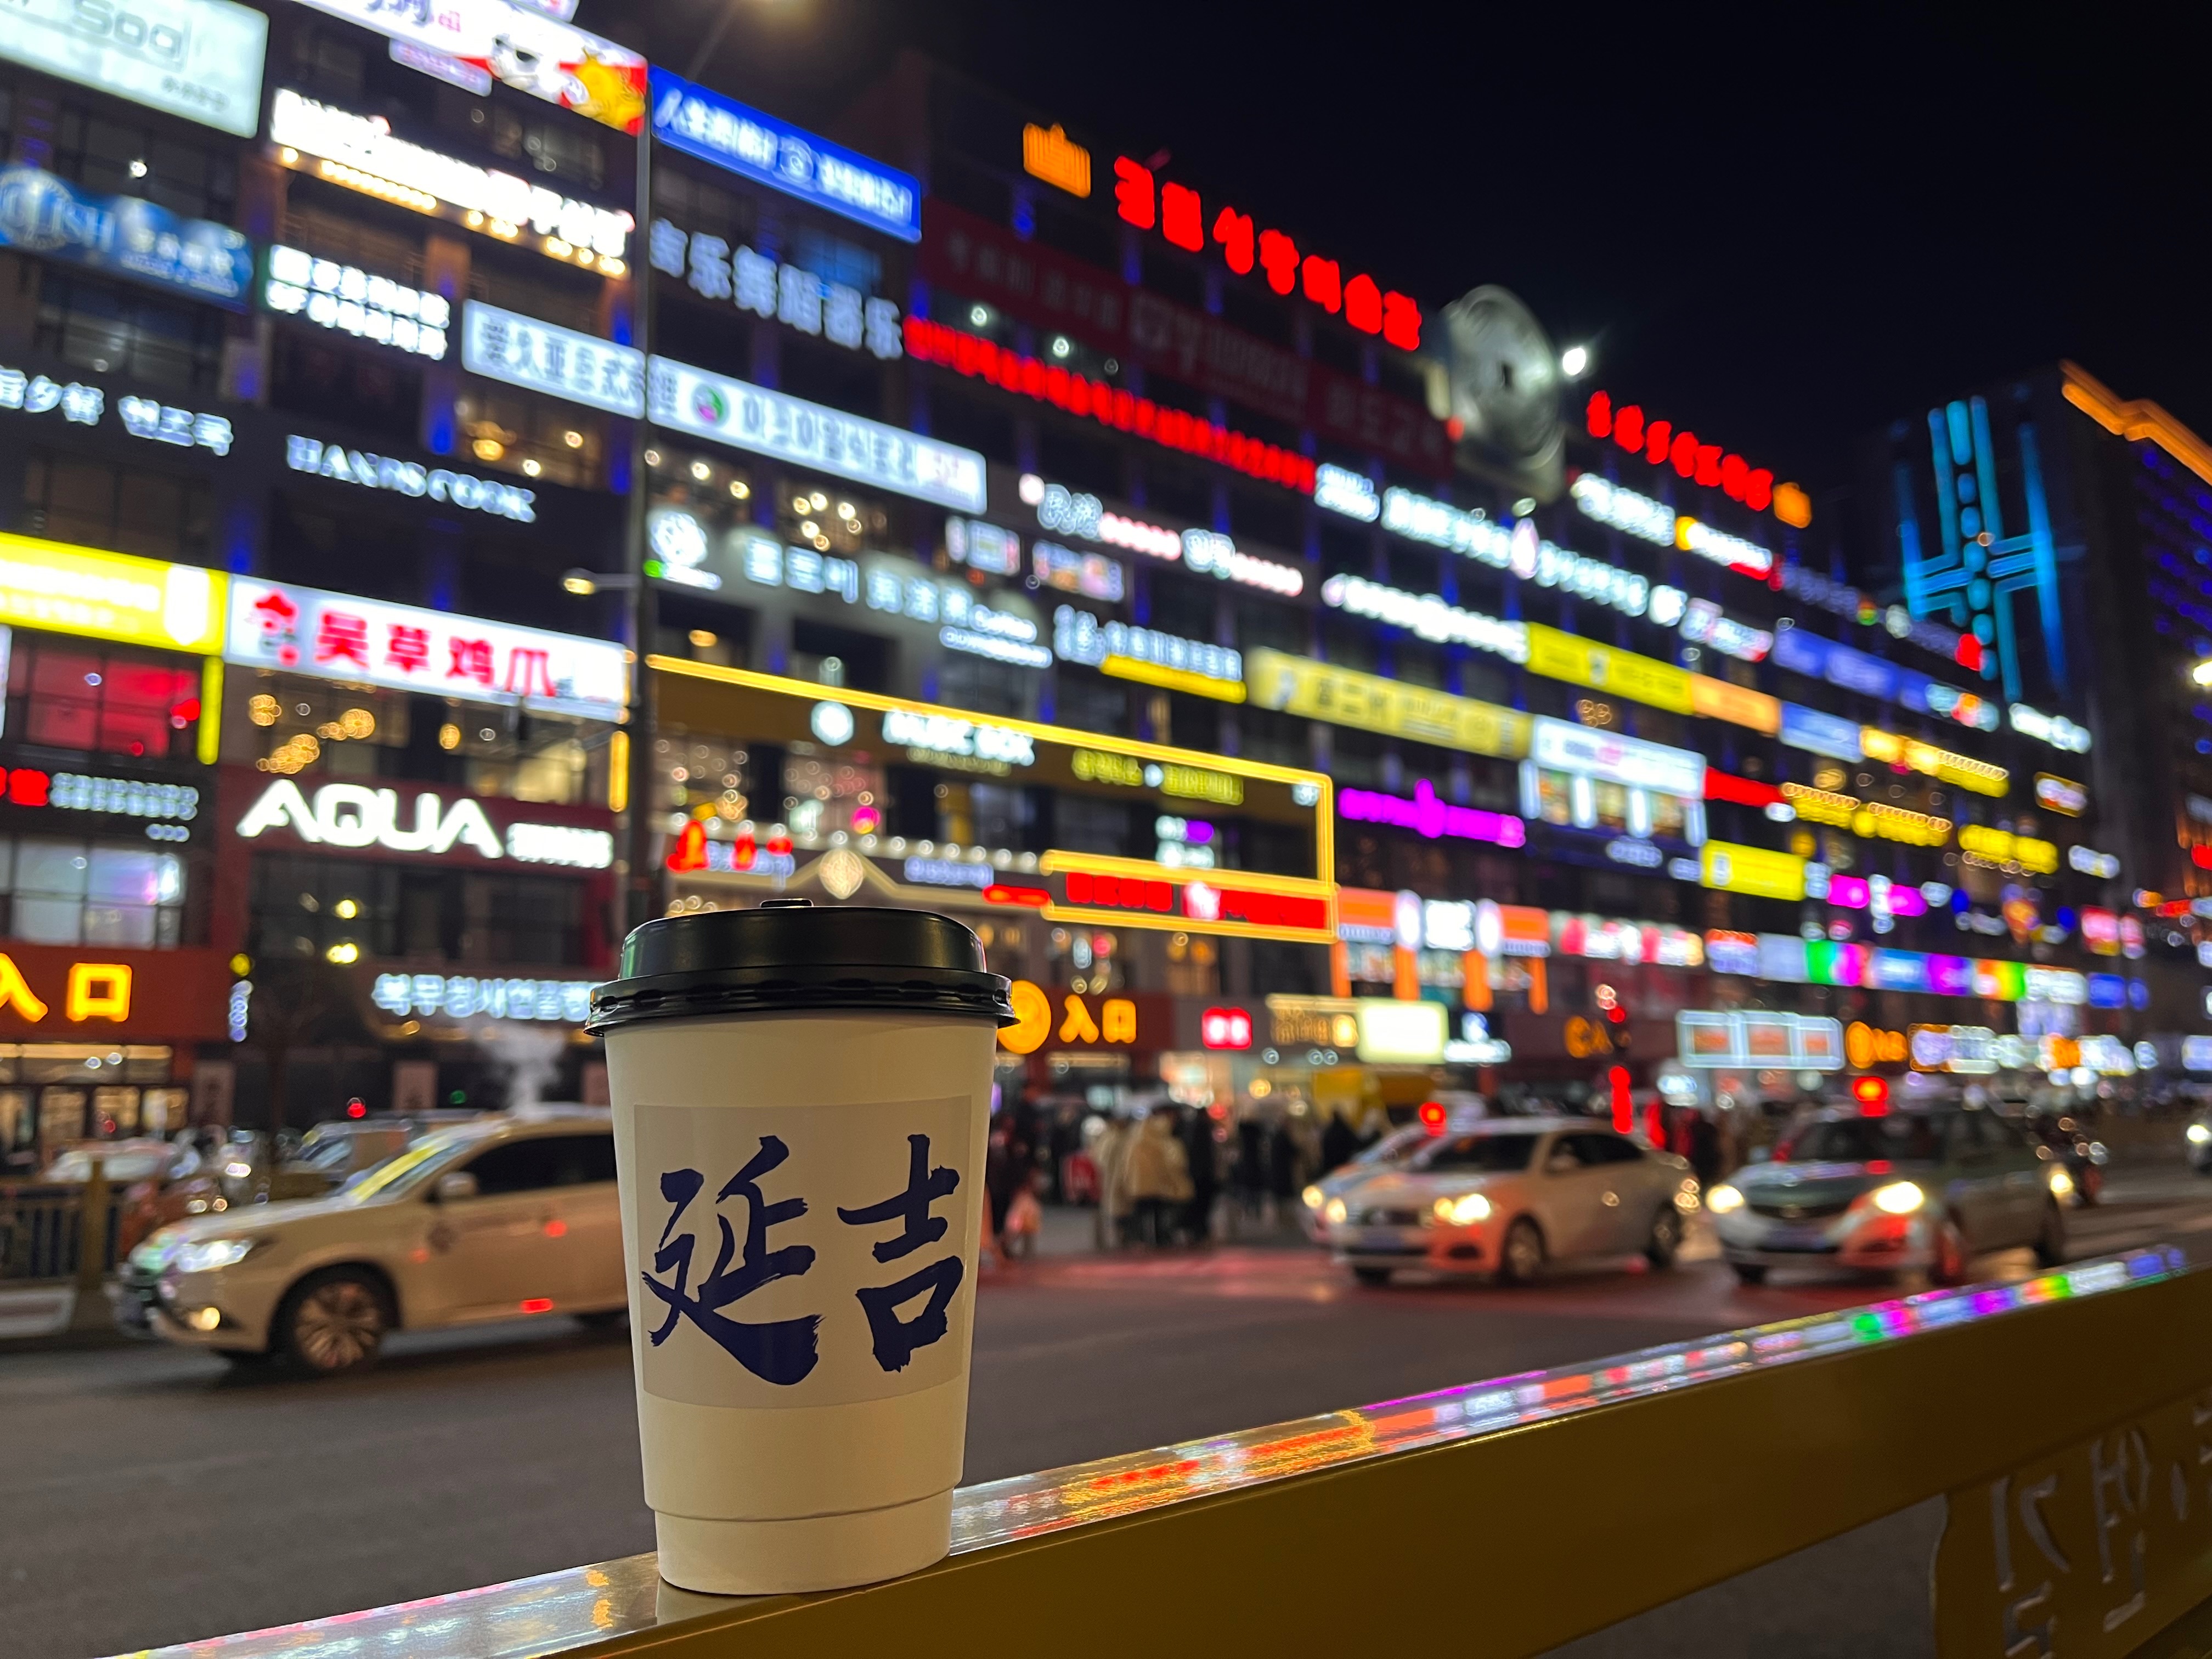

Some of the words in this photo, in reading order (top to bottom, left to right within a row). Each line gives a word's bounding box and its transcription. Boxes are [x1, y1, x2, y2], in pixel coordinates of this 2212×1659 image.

[236, 778, 504, 859] AQUA
[1059, 994, 1137, 1043] 入口
[641, 1134, 964, 1386] 延吉
